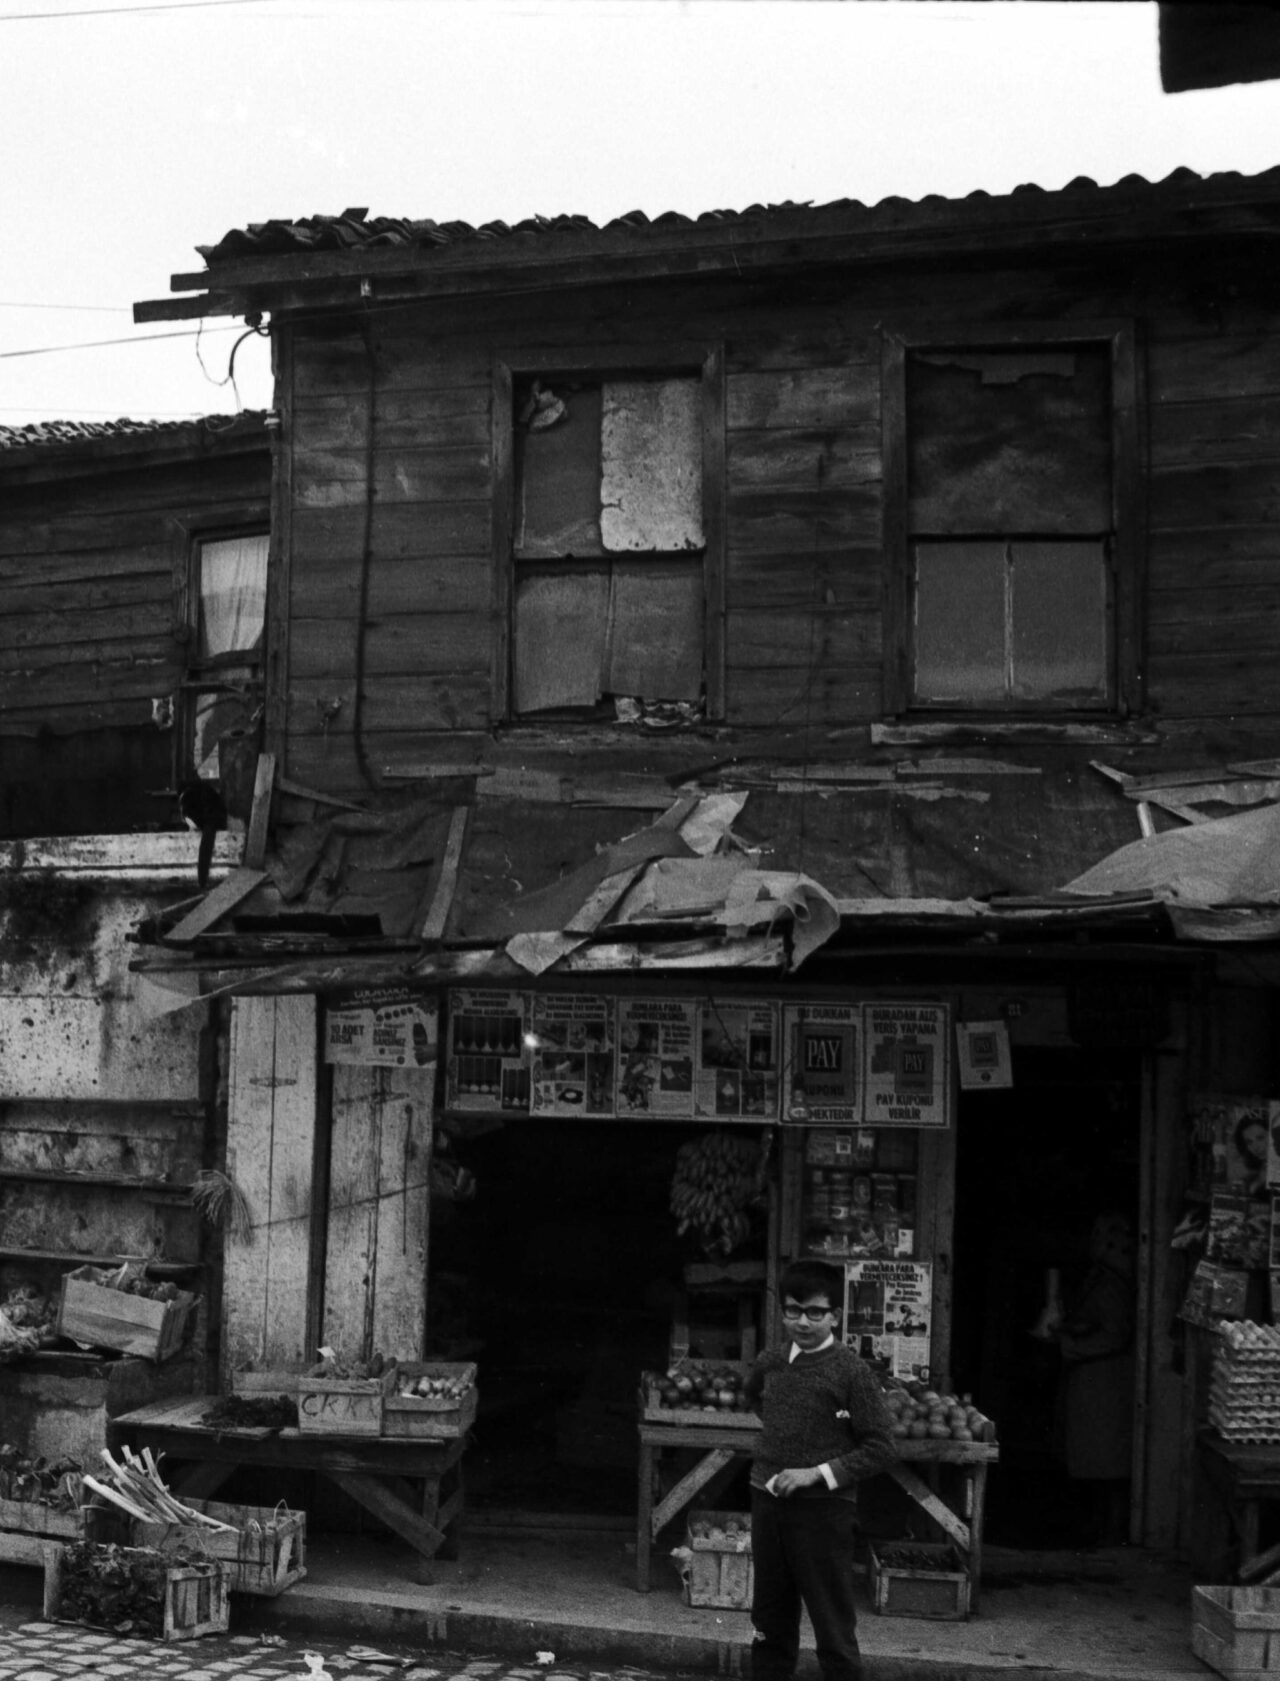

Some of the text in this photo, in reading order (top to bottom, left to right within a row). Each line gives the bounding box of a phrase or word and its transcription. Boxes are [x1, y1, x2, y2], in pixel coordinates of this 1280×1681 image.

[872, 1009, 917, 1021] BURADAN
[806, 1038, 841, 1069] PAY
[904, 1053, 925, 1072] PAY
[876, 1093, 934, 1106] PAY KUPONU
